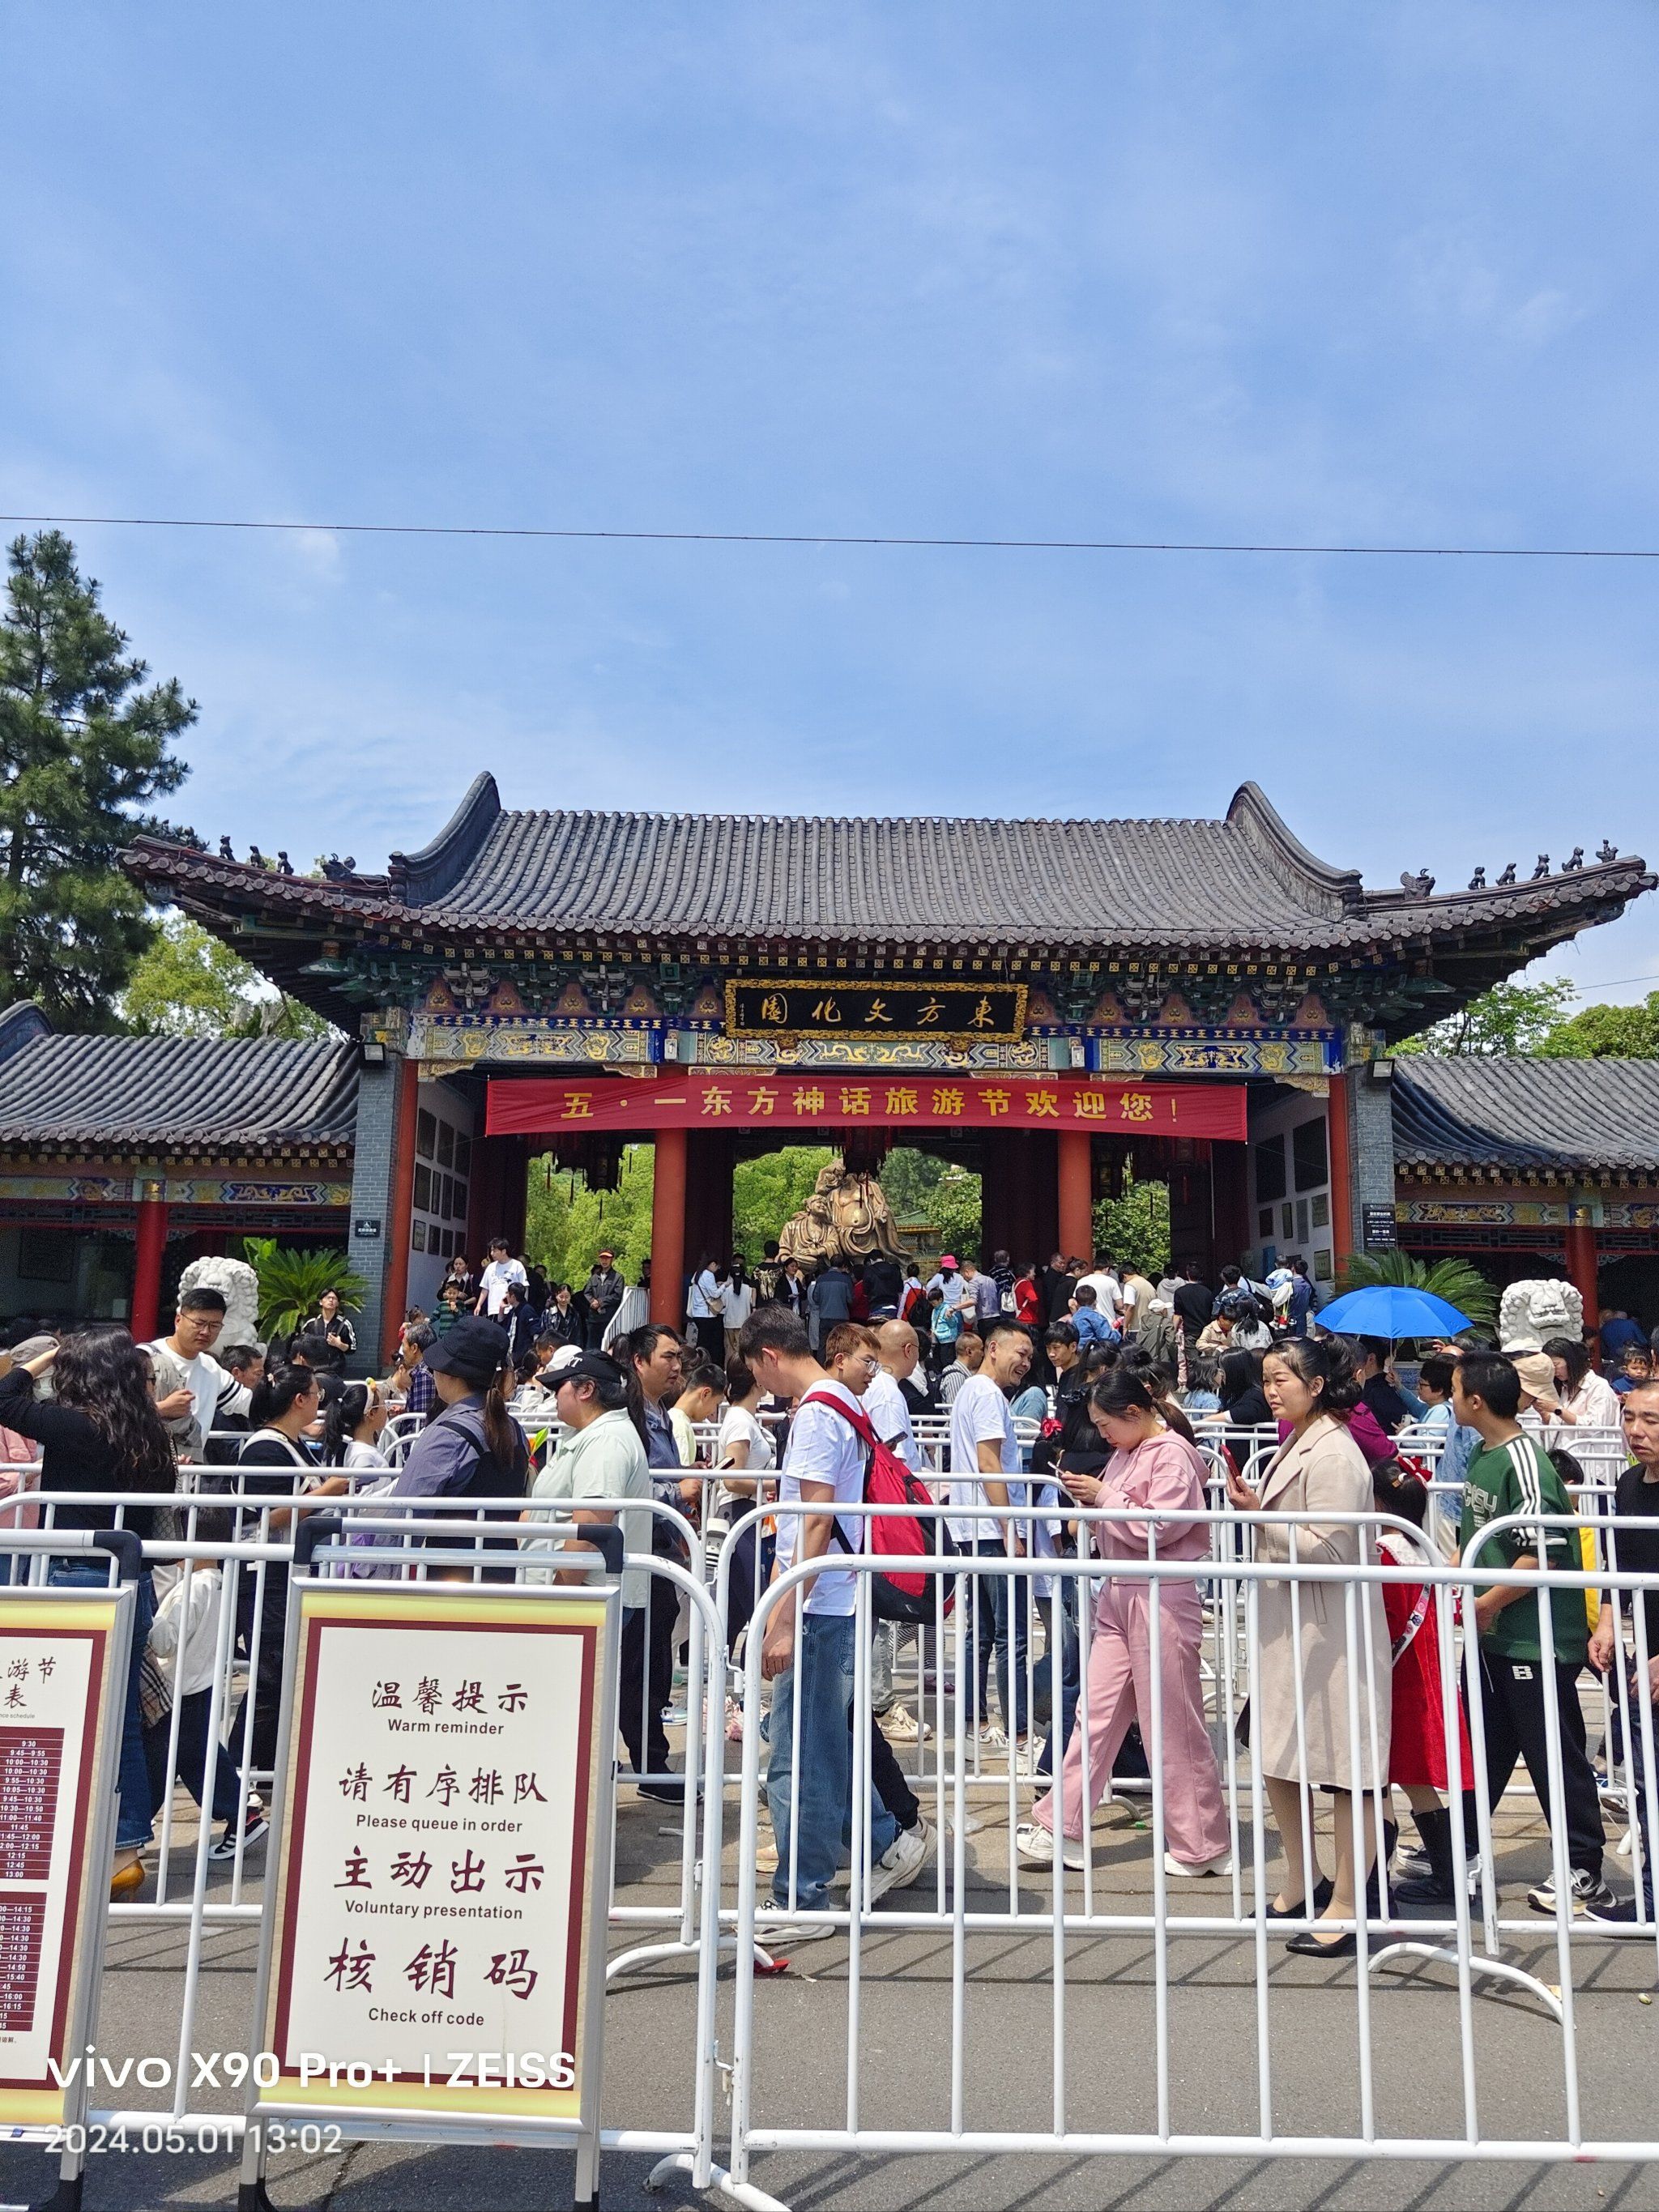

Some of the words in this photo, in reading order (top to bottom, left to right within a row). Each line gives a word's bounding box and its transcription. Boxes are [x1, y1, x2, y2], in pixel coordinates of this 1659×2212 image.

[0, 1656, 57, 1684] 游节
[4, 1683, 28, 1709] 表
[372, 1675, 528, 1715] 温馨提示
[387, 1719, 430, 1733] Warm
[435, 1721, 505, 1735] reminder
[339, 1762, 548, 1807] 请有序排队
[356, 1814, 407, 1828] Please
[412, 1818, 458, 1832] queue
[463, 1818, 476, 1831] in
[481, 1819, 523, 1832] order
[334, 1844, 544, 1894] 主动出示
[345, 1899, 420, 1919] Voluntary
[424, 1903, 522, 1920] presentation
[323, 1937, 539, 2001] 核销码
[369, 2008, 417, 2023] Check
[421, 2010, 444, 2024] off
[447, 2012, 484, 2026] code
